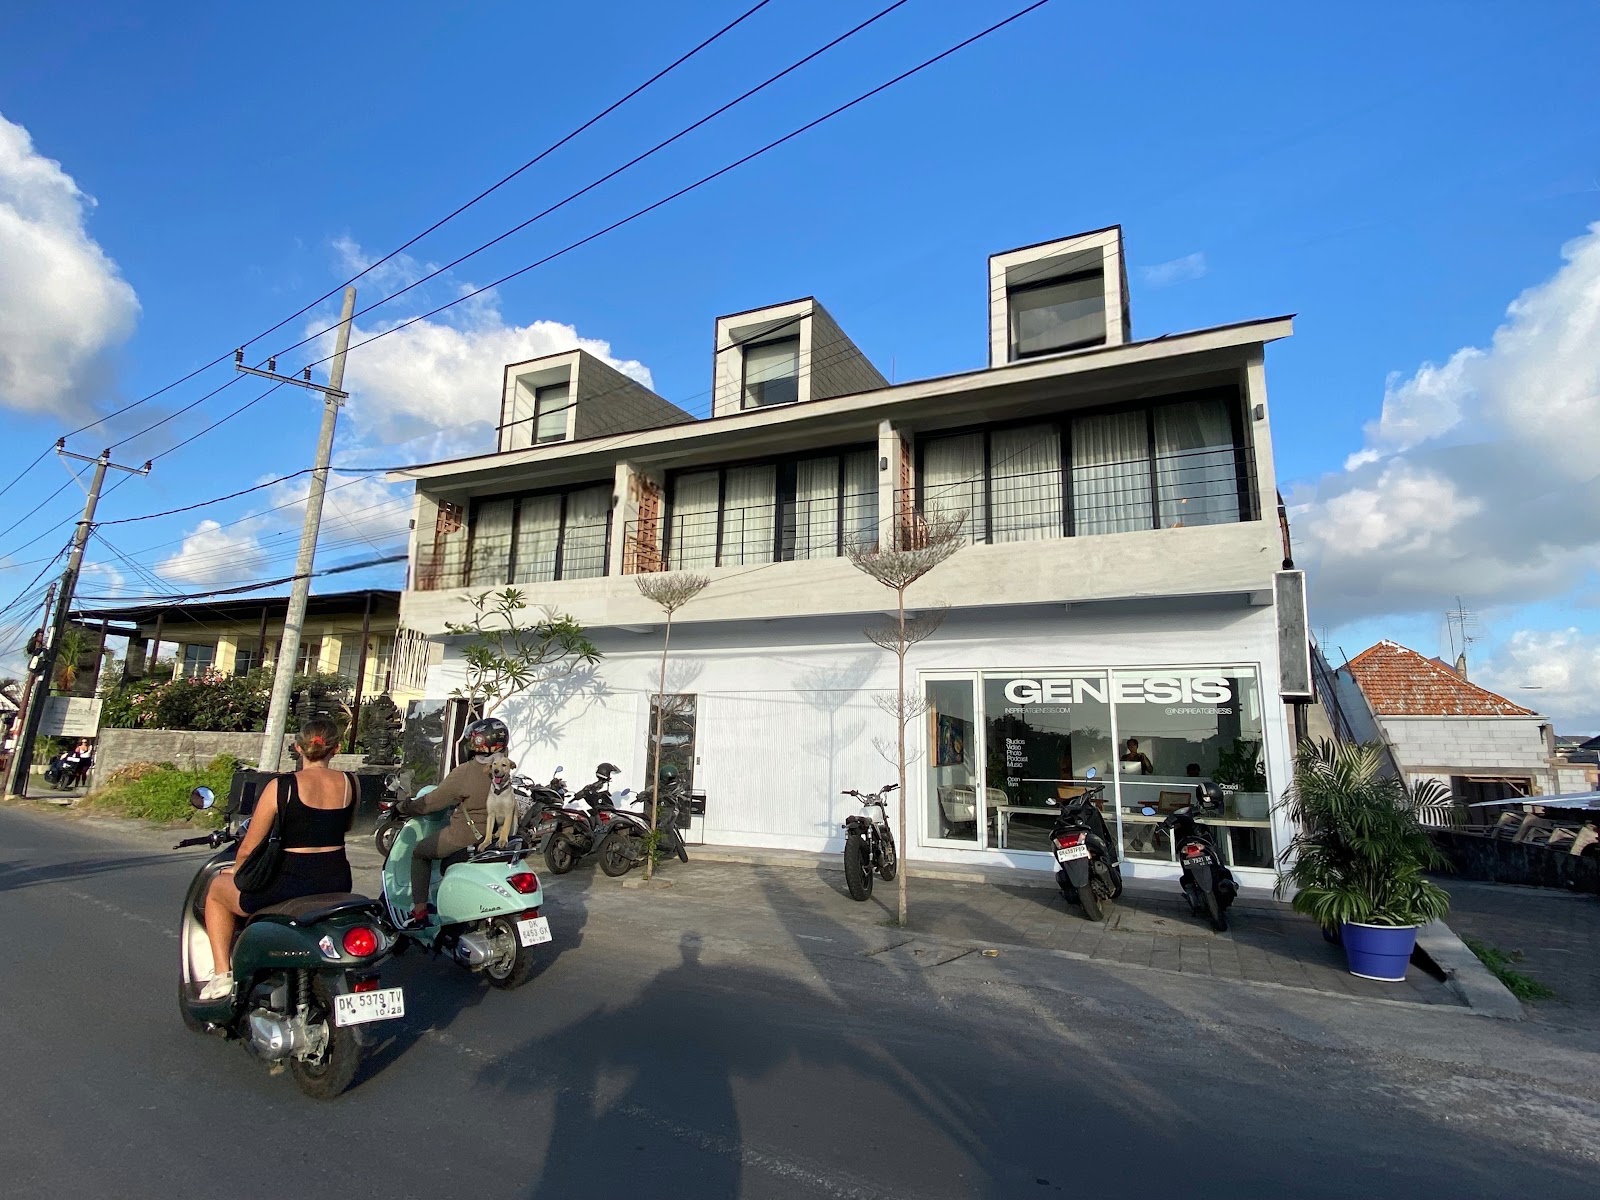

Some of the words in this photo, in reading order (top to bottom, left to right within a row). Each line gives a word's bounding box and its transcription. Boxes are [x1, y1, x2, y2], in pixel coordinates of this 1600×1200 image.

[1004, 677, 1232, 704] GENESIS
[1164, 707, 1232, 715] @INSPIREATGENESIS
[528, 920, 539, 928] DK
[339, 997, 353, 1010] DK
[360, 993, 385, 1007] 5379
[389, 990, 401, 1003] TV
